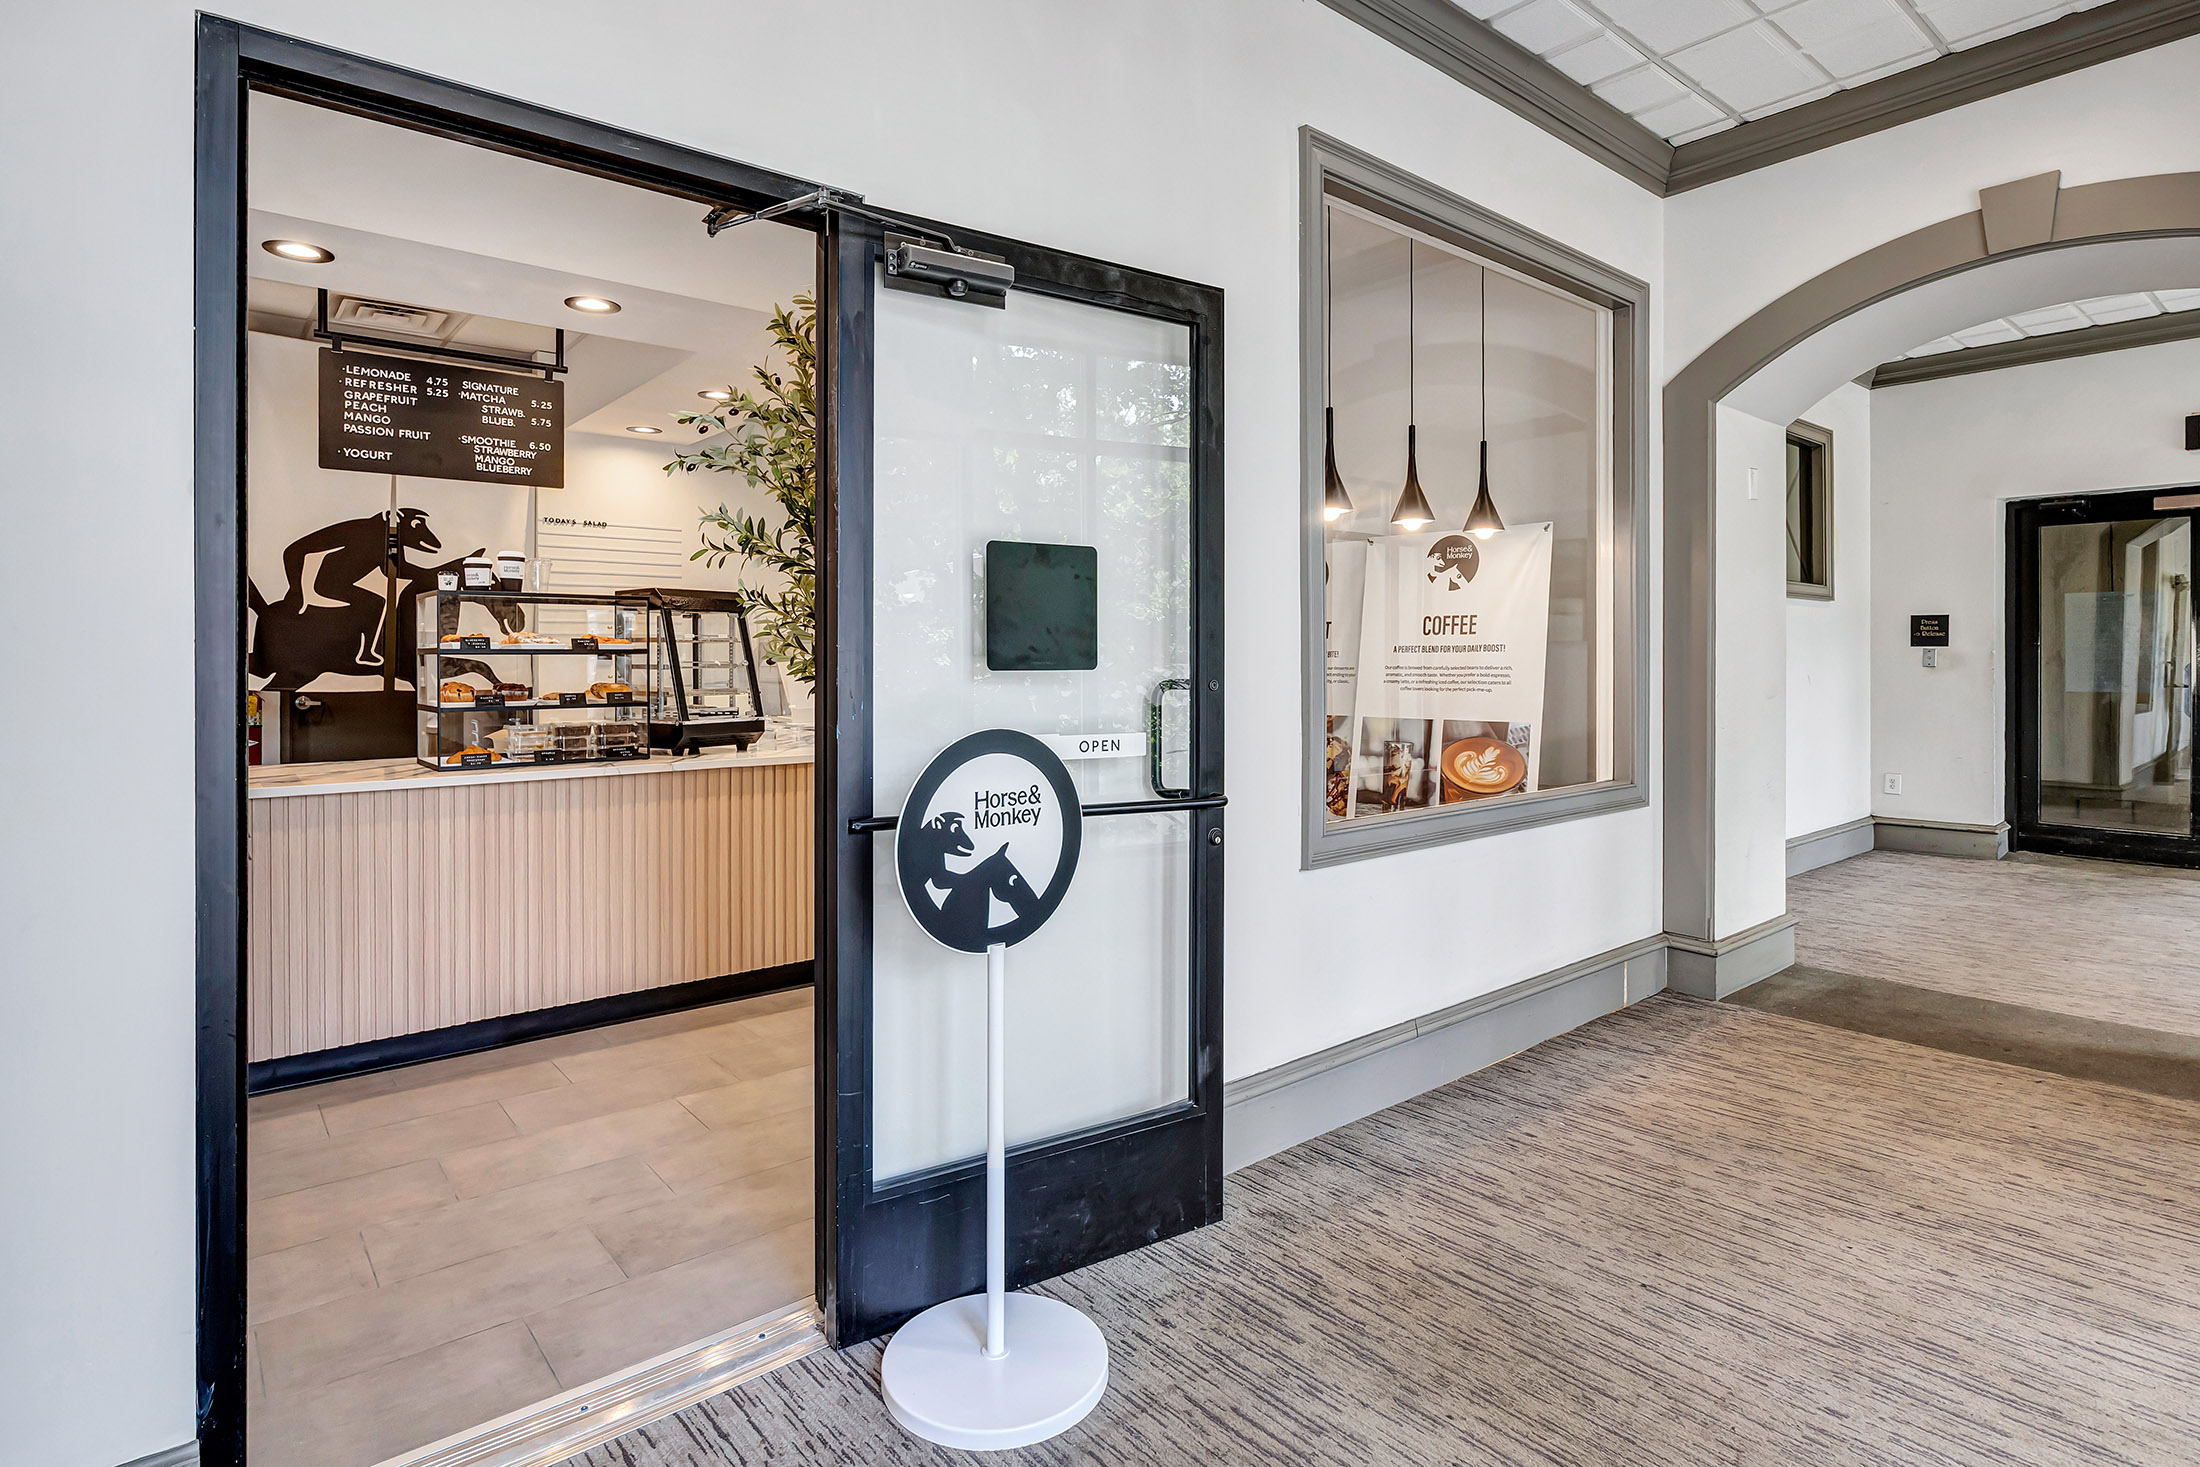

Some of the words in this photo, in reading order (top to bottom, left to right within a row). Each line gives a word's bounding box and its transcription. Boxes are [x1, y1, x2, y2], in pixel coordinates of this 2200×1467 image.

[346, 365, 412, 382] LEMONADE
[426, 377, 449, 386] 4.75
[344, 378, 418, 394] REFRESHER
[426, 388, 449, 398] 5.25
[462, 381, 519, 396] SIGNATURE
[344, 391, 418, 406] GRAPEFRUIT
[460, 392, 506, 404] MATCHA
[344, 401, 387, 413] PEACH
[481, 405, 525, 418] STRAWB.
[531, 400, 552, 410] 5.25
[344, 412, 391, 425] MANGO
[482, 416, 516, 427] BLUEB.
[531, 418, 552, 427] 5.75
[343, 424, 394, 437] PASSION
[399, 430, 431, 441] FRUIT
[461, 435, 516, 448] SMOOTHIE
[529, 442, 551, 451] 6.50
[343, 448, 392, 460] YOGURT
[474, 445, 537, 459] STRAWBERRY
[475, 455, 515, 466] MANGO
[476, 463, 532, 476] BLUEBERRY
[1446, 544, 1472, 552] Horse&
[1446, 552, 1472, 560] Monkey
[1422, 614, 1478, 636] COFFEE
[1422, 645, 1439, 653] BLEND
[1440, 645, 1450, 653] FOR
[1452, 645, 1467, 653] YOUR
[1467, 644, 1483, 652] DAILY
[1483, 644, 1506, 652] BOOST!
[1079, 739, 1120, 753] OPEN
[974, 784, 1042, 810] Horse&
[974, 806, 1042, 830] Monkey
